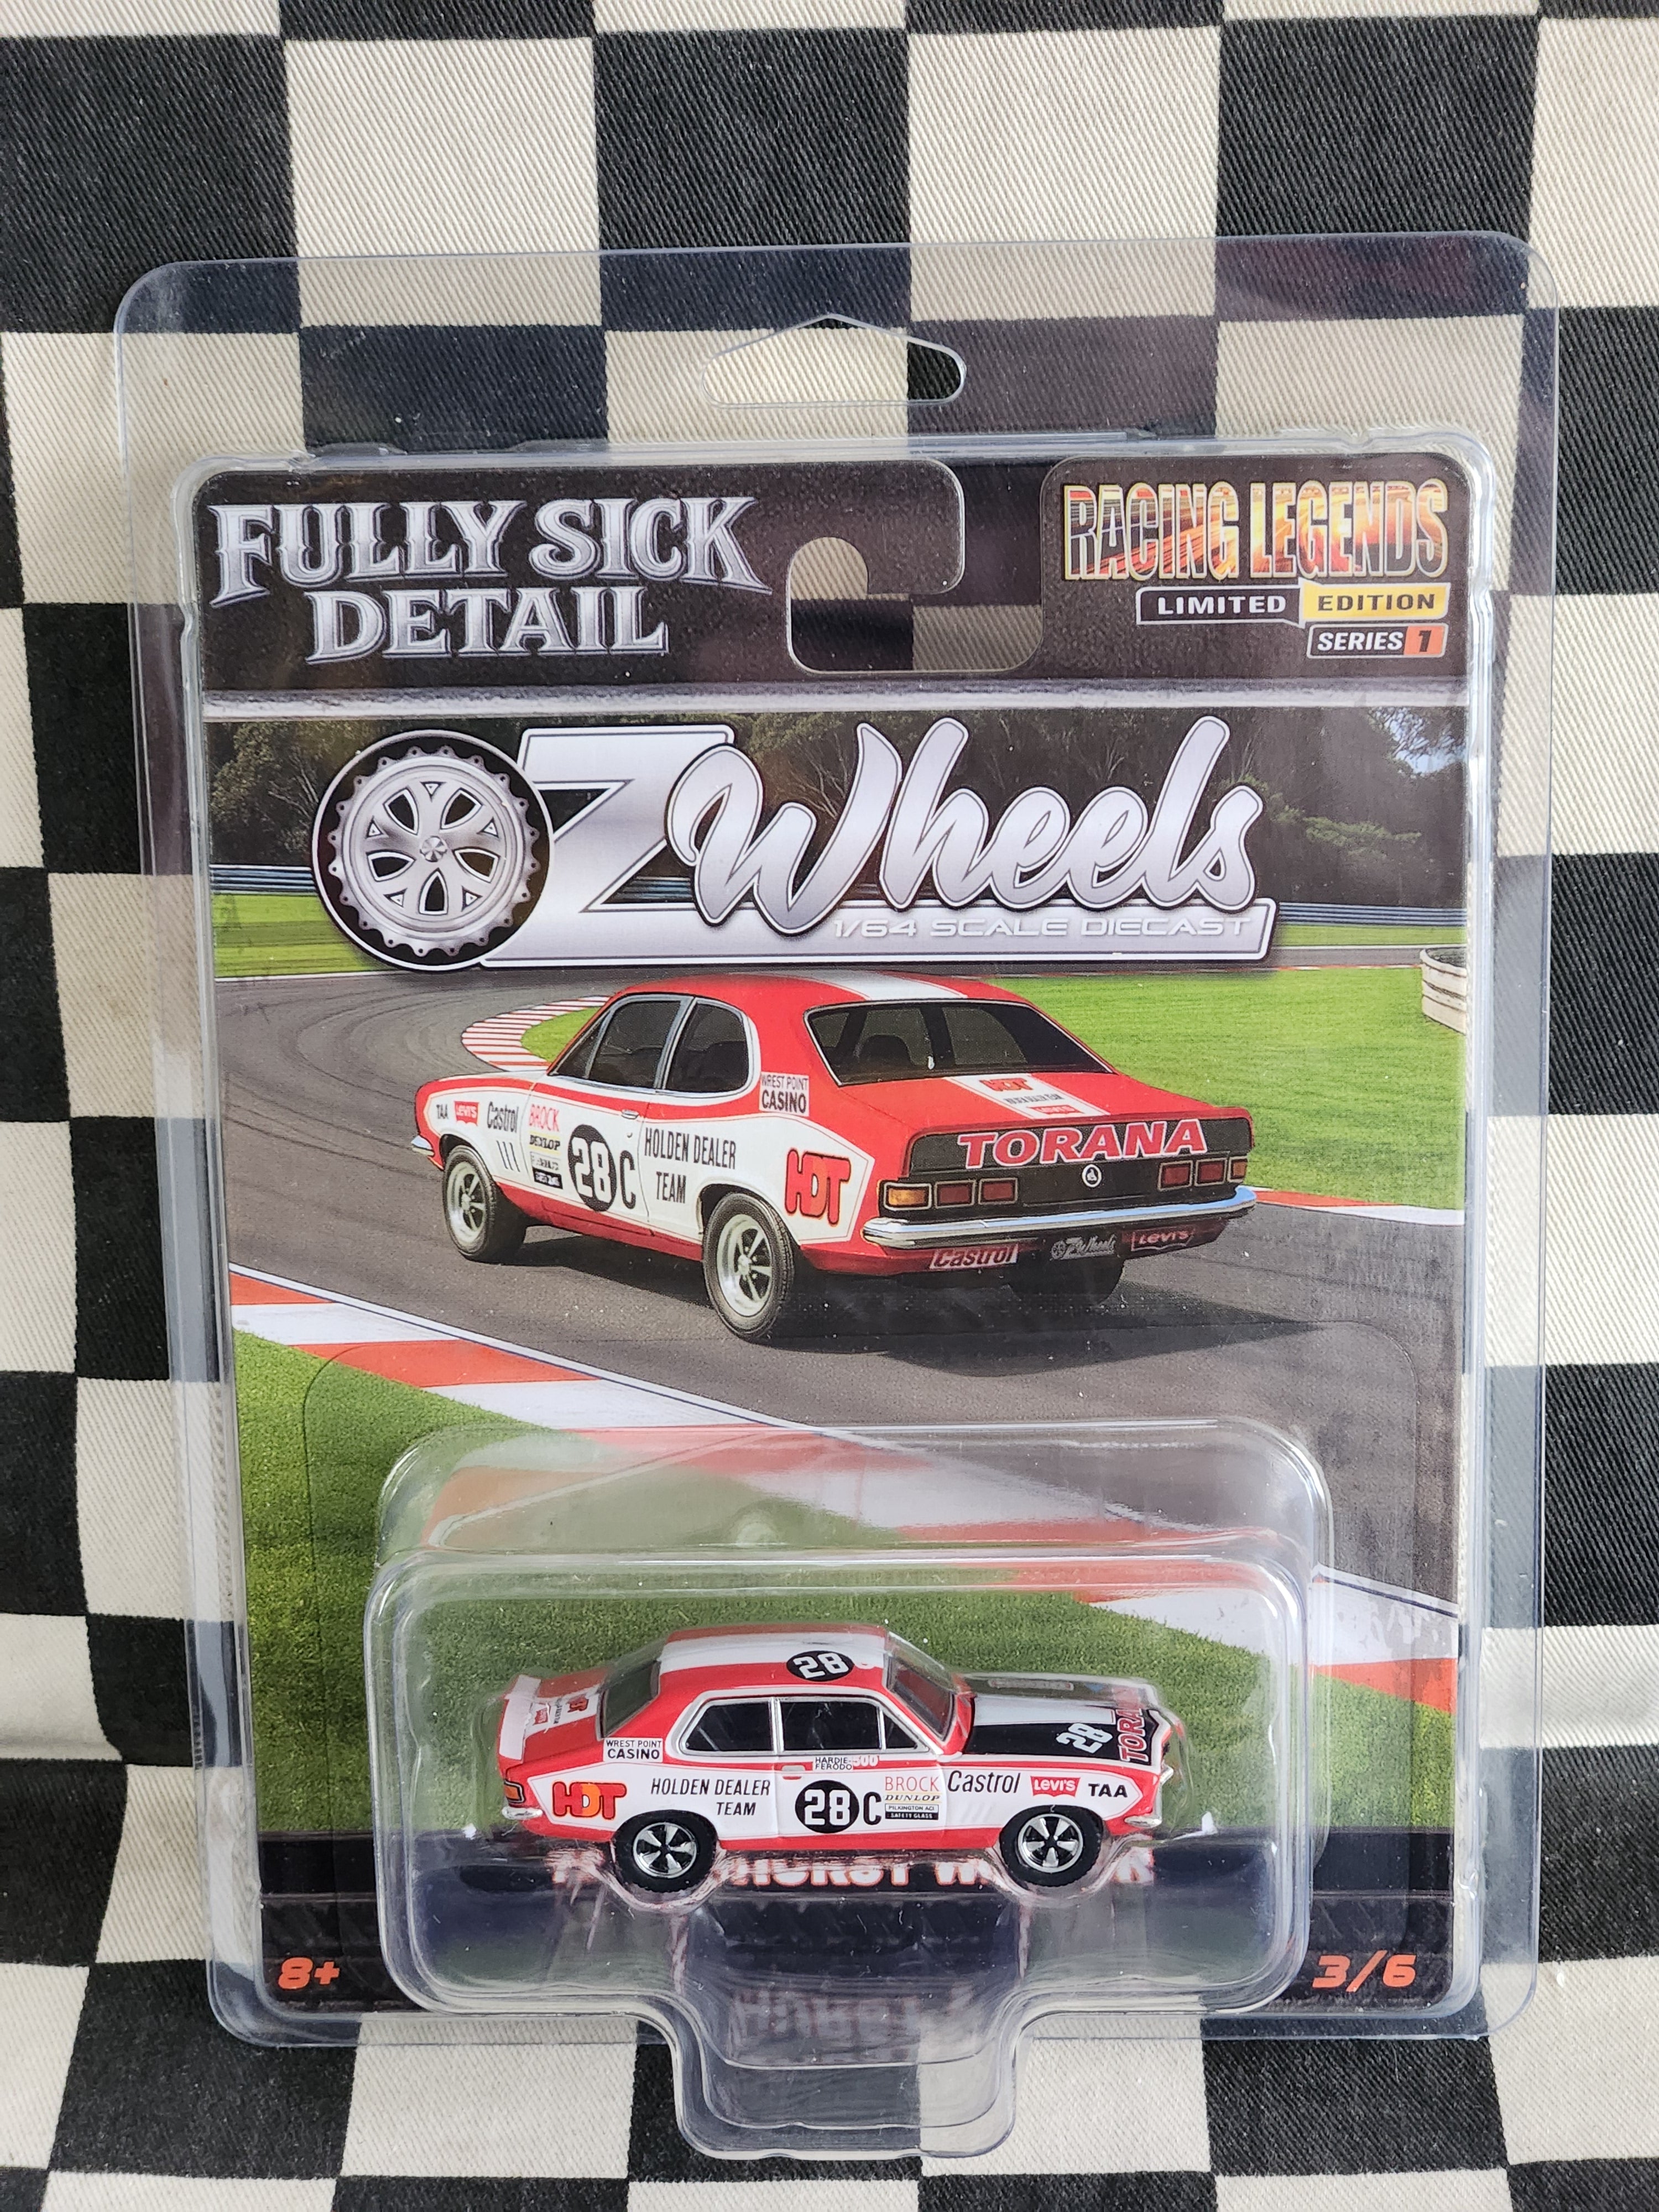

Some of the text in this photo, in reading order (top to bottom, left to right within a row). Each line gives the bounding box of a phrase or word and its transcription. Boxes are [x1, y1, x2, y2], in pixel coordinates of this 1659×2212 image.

[1063, 479, 1450, 581] RACING LEGENDS
[207, 496, 774, 608] FULLY SICK
[1157, 593, 1436, 615] LIMITED EDITION
[304, 585, 669, 665] DETAIL
[1317, 630, 1432, 652] SERIES 1
[665, 715, 1265, 936] Wheels
[833, 916, 1253, 937] 1/64 SCALE DIECAST
[487, 1101, 519, 1133] Castrol
[761, 1089, 807, 1114] CASINO
[529, 1104, 560, 1131] BROCK
[644, 1128, 737, 1170] HOLDEN DEALER
[957, 1118, 1209, 1170] TORANA
[573, 1137, 637, 1210] 28 C
[655, 1170, 687, 1204] TEAM
[785, 1147, 852, 1227] HDT
[932, 1246, 1019, 1267] Castrol
[792, 1652, 849, 1679] 28
[607, 1748, 660, 1760] CASINO
[1056, 1723, 1113, 1754] 28
[650, 1778, 771, 1796] HOLDEN DEALER
[885, 1776, 940, 1792] BROCK
[947, 1770, 1021, 1793] Castrol
[1088, 1783, 1128, 1798] TAA
[553, 1781, 627, 1820] HDT
[716, 1802, 757, 1816] TEAM
[804, 1788, 882, 1825] 28 C
[278, 1957, 340, 1990] 8+
[1312, 1949, 1417, 1993] 3/6
